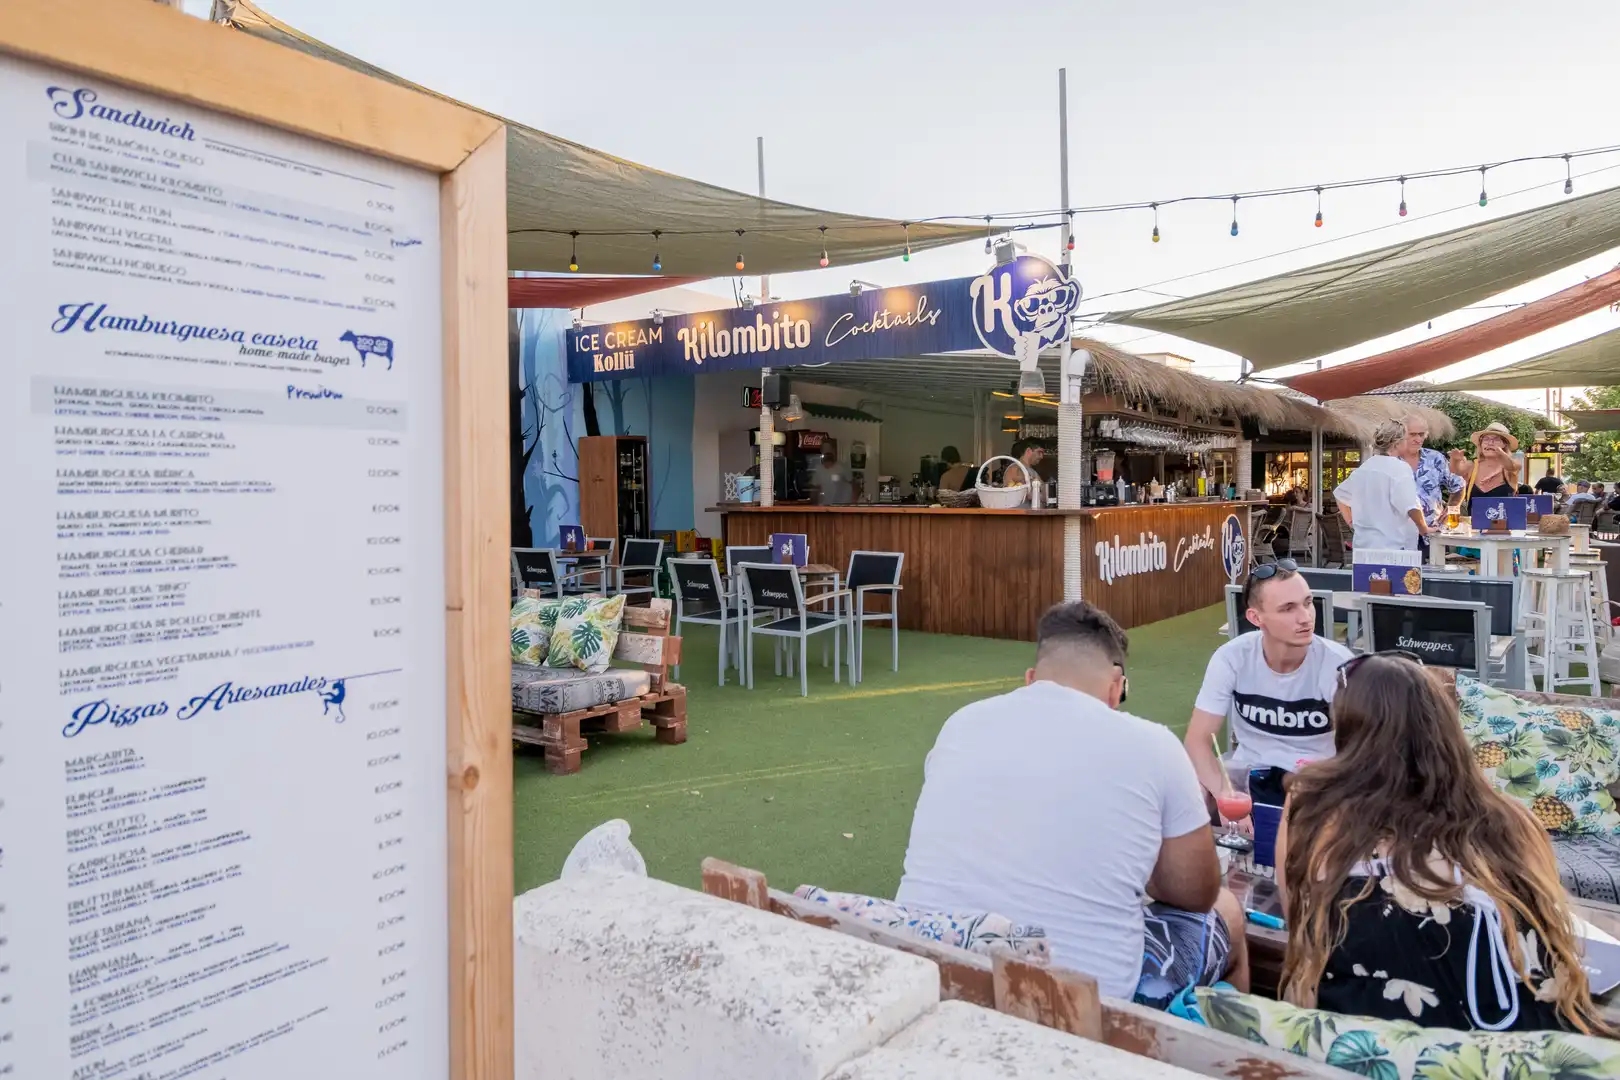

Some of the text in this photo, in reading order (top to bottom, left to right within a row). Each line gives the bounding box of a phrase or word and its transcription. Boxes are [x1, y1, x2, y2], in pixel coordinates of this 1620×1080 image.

[46, 86, 196, 142] Sandwich
[89, 159, 158, 183] SANDWICH
[51, 187, 122, 209] SANDWICH
[51, 216, 174, 246] SANDWICH VEGETAL
[51, 247, 123, 268] SANDWICH
[124, 258, 188, 277] NORUEGO
[970, 272, 1021, 338] K
[51, 302, 320, 352] Hamburguesa casera
[575, 294, 942, 365] ICE CREAM Kilombito Cocktails
[313, 351, 352, 368] burger
[593, 350, 635, 372] Kollü
[54, 384, 150, 401] HAMBURGUESA
[54, 424, 150, 439] HAMBURGUESA
[55, 468, 150, 479] HAMBURGUESA
[56, 509, 151, 521] HAMBURGUESA
[56, 548, 152, 562] HAMBURGUESA
[1095, 524, 1216, 586] Kilombito Cocktails
[57, 585, 153, 601] HAMBURGUESA
[57, 618, 154, 638] HAMBURGUESA
[58, 649, 233, 679] HAMBURGUESA VEGETARIANA
[62, 698, 170, 738] Pizzas
[176, 675, 328, 721] Artesanales
[1236, 701, 1329, 729] umbro
[65, 747, 137, 769] MARGARITA
[68, 914, 151, 947] VEGETARIANA
